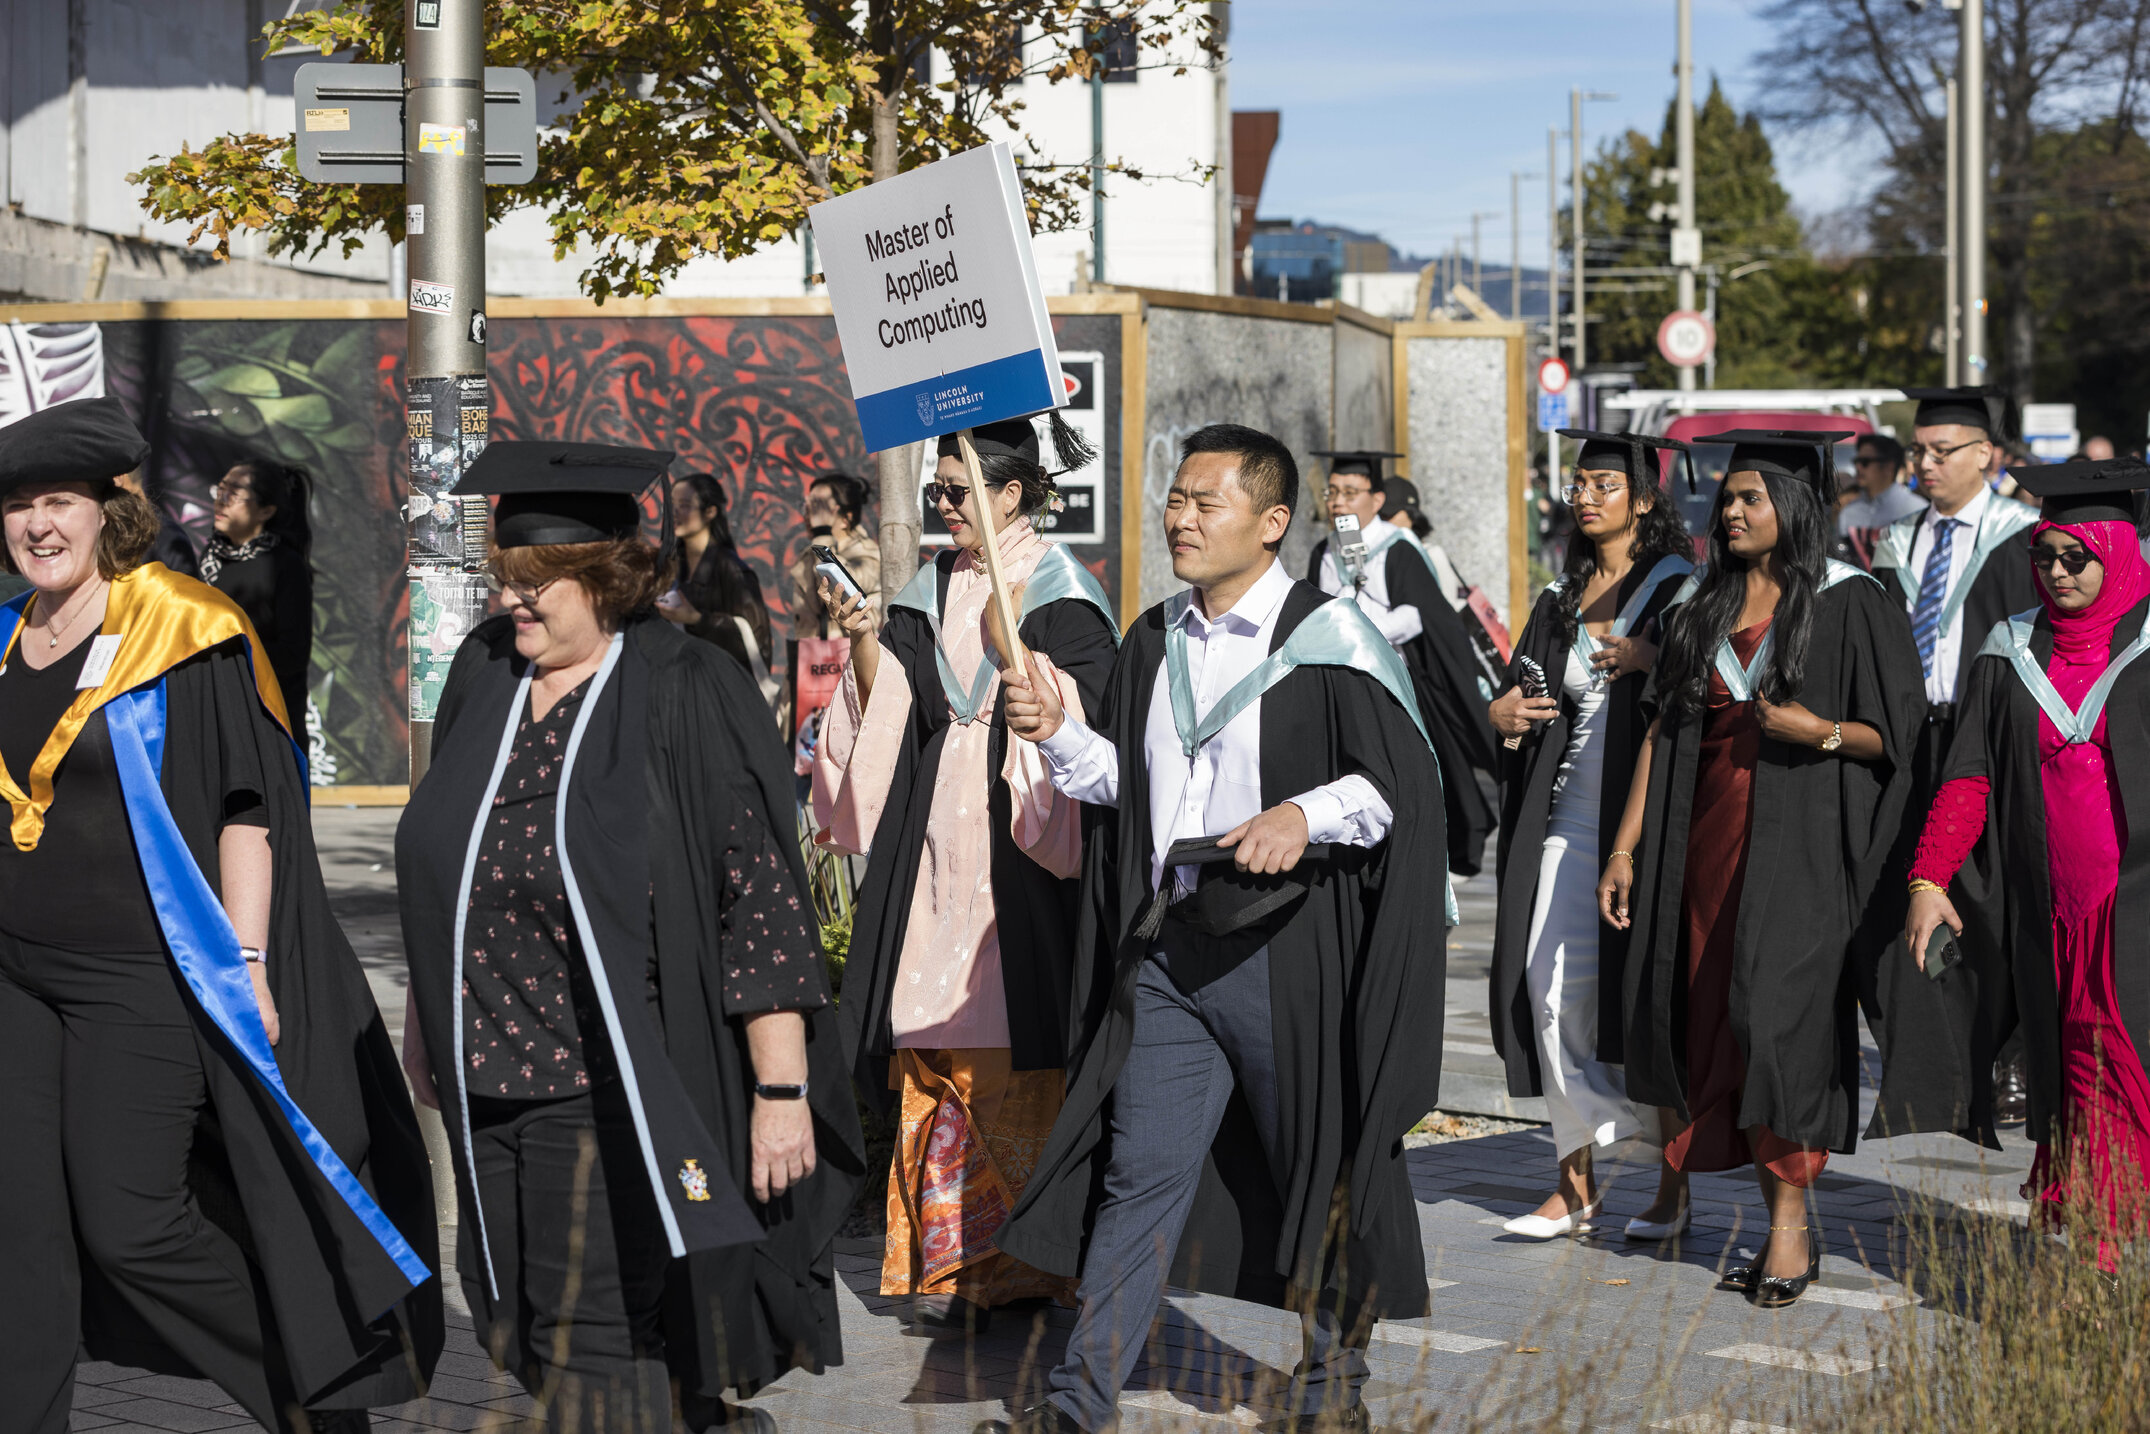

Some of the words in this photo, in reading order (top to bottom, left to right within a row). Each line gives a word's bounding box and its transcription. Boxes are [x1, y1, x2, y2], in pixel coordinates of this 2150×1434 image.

[865, 222, 931, 262] Master
[934, 204, 955, 240] of
[884, 250, 959, 305] Applied
[878, 297, 987, 349] Computing
[934, 385, 968, 401] LINCOLN
[936, 391, 984, 411] UNIVERSITY
[465, 587, 475, 599] TE
